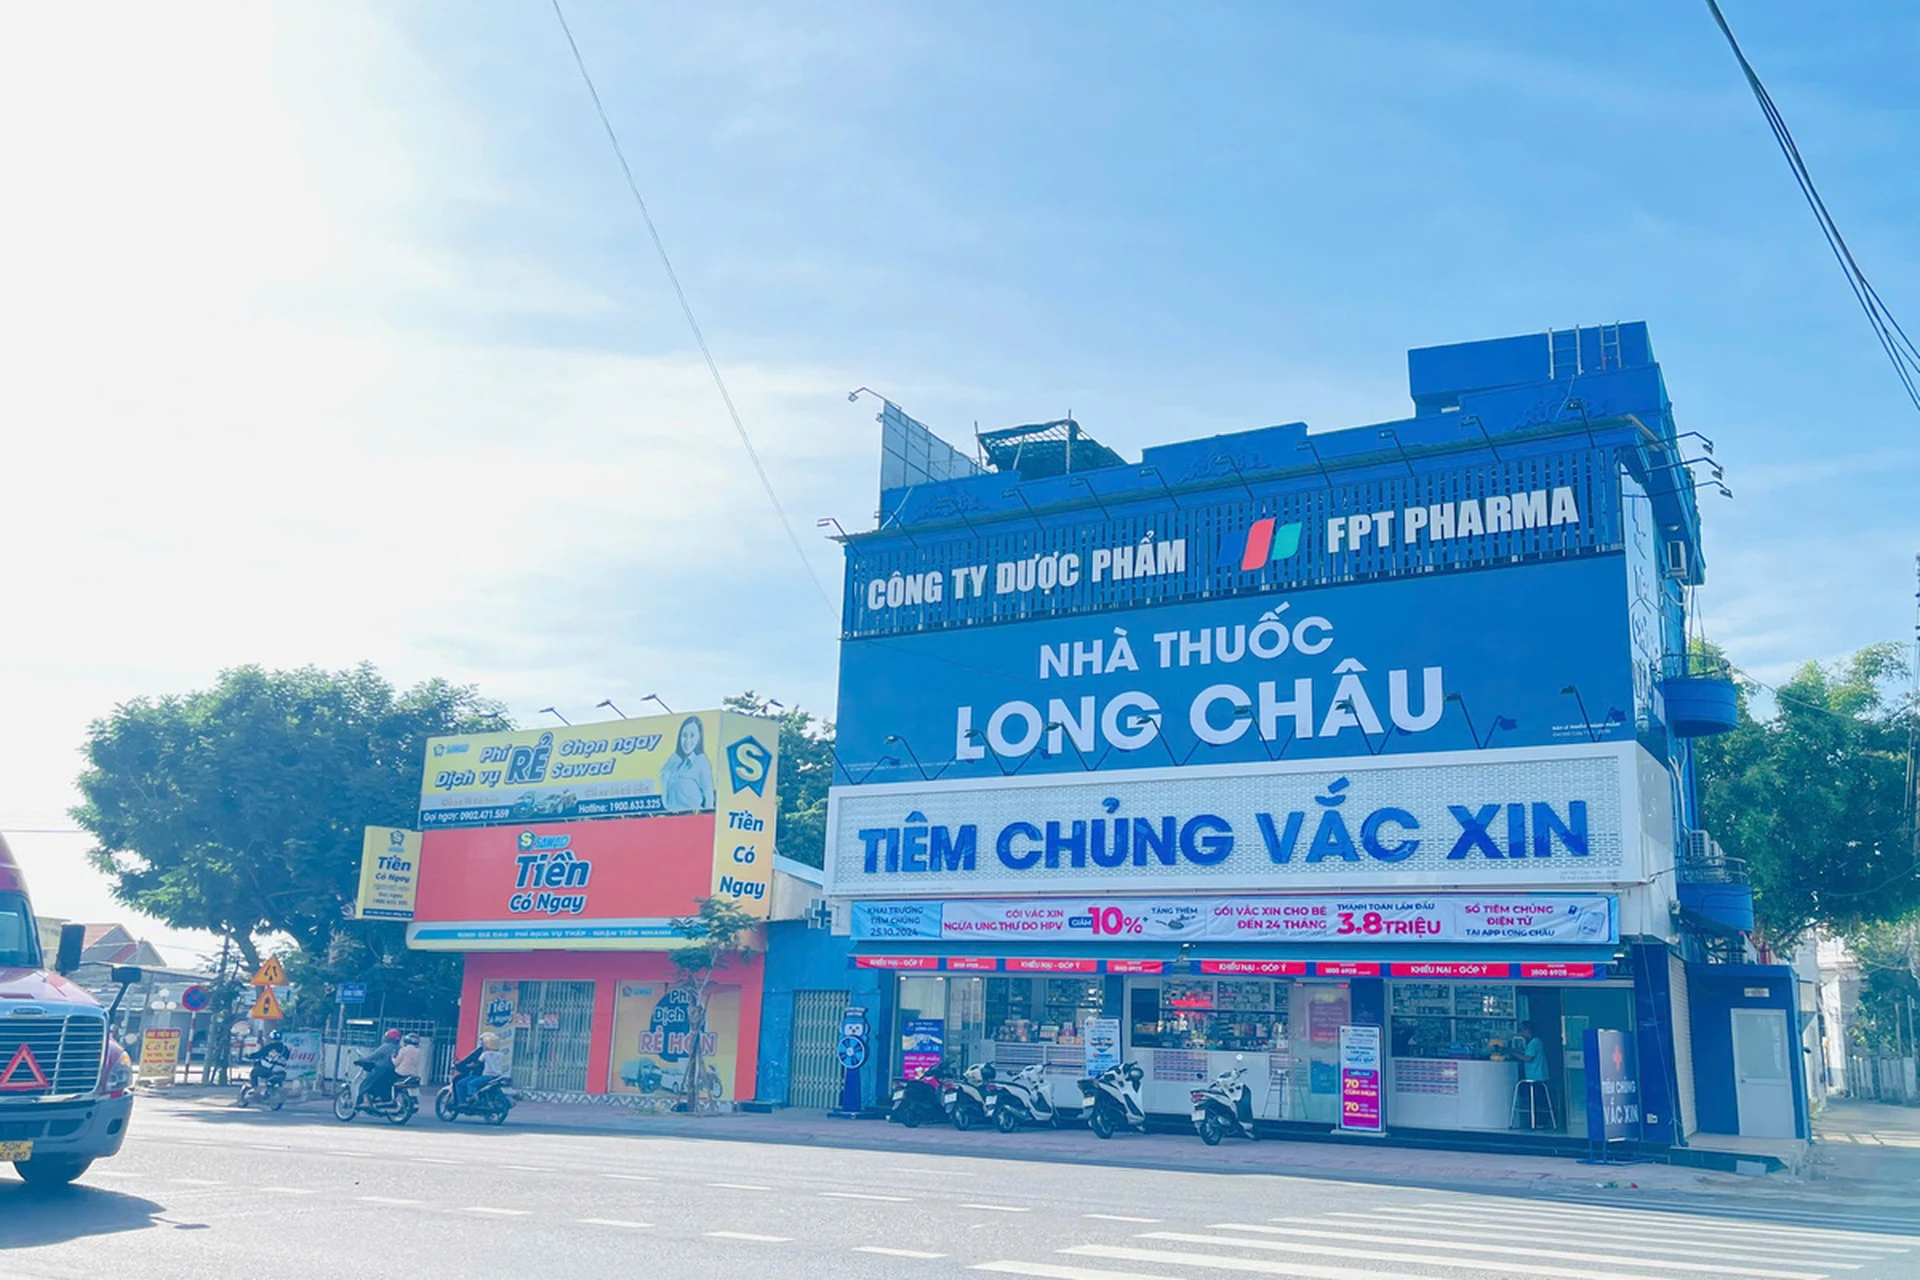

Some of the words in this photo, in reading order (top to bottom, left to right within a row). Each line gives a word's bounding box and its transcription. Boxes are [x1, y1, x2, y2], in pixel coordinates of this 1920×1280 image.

[1327, 510, 1395, 554] FPT
[1404, 486, 1580, 544] PHARMA
[868, 571, 943, 610] CÔNG
[952, 565, 988, 600] TY
[996, 551, 1080, 595] DƯỢC
[1091, 530, 1186, 583] PHẨM
[1039, 626, 1139, 680] NHÀ
[1153, 601, 1335, 669] THUỐC
[956, 691, 1162, 761] LONG
[1190, 657, 1446, 747] CHÂU
[480, 744, 512, 763] Phí
[559, 738, 608, 759] Chọn
[611, 734, 663, 755] ngay
[505, 731, 554, 785] RẺ
[551, 757, 616, 779] Sawad
[435, 769, 475, 790] Dịch
[479, 770, 501, 787] vụ
[728, 810, 764, 832] Tiền
[858, 810, 977, 873] TIÊM
[996, 797, 1234, 869] CHỦNG
[1255, 776, 1420, 863] VẮC
[1446, 800, 1590, 859] XIN
[378, 854, 412, 872] Tiền
[732, 846, 756, 865] Có
[515, 850, 592, 888] Tiền
[719, 875, 766, 900] Ngay
[508, 892, 535, 912] Có
[535, 891, 587, 915] Ngay
[1005, 908, 1023, 918] GÓI
[1047, 909, 1064, 918] XIN
[1214, 905, 1233, 916] GÓI
[1262, 907, 1281, 916] XIN
[1283, 907, 1309, 916] CHO
[1311, 905, 1327, 916] BÉ
[1337, 903, 1367, 911] THANH
[1483, 903, 1509, 914] TIÊM
[975, 921, 997, 931] UNG
[1022, 921, 1039, 931] DO
[1040, 921, 1064, 931] HPV
[1087, 906, 1143, 935] 10%
[1265, 920, 1281, 929] 24
[1283, 918, 1327, 929] THÁNG
[1337, 911, 1382, 935] 3.8
[1382, 916, 1441, 938] TRIỆU
[1502, 929, 1528, 937] LONG
[1459, 964, 1479, 974] GÓP
[653, 1006, 685, 1026] Dịch
[639, 1025, 664, 1054] RẺ
[1344, 1079, 1359, 1089] 70
[1344, 1102, 1359, 1112] 70
[1623, 1104, 1639, 1124] XIN
